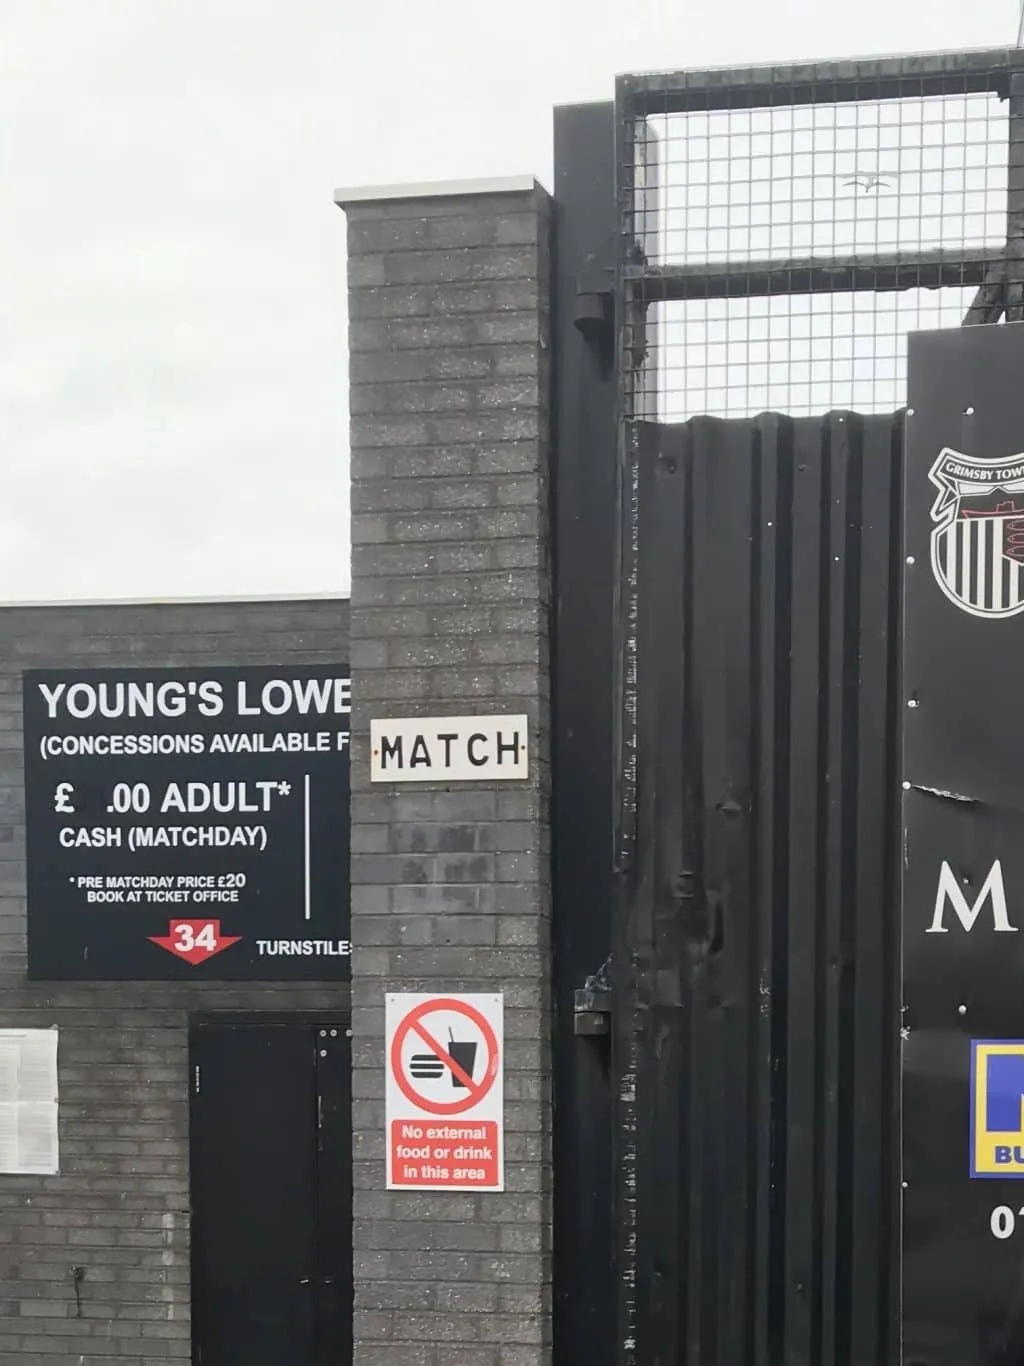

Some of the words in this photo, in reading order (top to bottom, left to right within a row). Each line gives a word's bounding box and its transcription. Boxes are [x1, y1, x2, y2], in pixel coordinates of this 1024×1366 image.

[946, 461, 993, 480] GRIMSBY
[38, 681, 224, 718] YOUNG'S
[238, 679, 351, 716] LOWE
[40, 734, 204, 759] (CONCESSIONS
[209, 732, 331, 753] AVAILABLE
[381, 731, 519, 769] MATCH
[59, 827, 122, 847] CASH
[128, 826, 268, 851] (MATCHDAY)
[78, 876, 103, 889] PRE
[106, 876, 174, 889] MATCHDAY
[177, 876, 215, 888] PRICE
[217, 873, 246, 888] £20
[87, 891, 124, 903] BOOK
[126, 891, 141, 903] AT
[145, 890, 190, 902] TICKET
[193, 890, 239, 902] OFFICE
[173, 924, 217, 952] 34
[402, 1125, 422, 1139] No
[426, 1126, 486, 1140] external
[396, 1145, 430, 1159] food
[433, 1148, 450, 1159] or
[453, 1145, 492, 1160] drink
[403, 1165, 417, 1178] in
[421, 1165, 449, 1178] this
[453, 1168, 485, 1179] area
